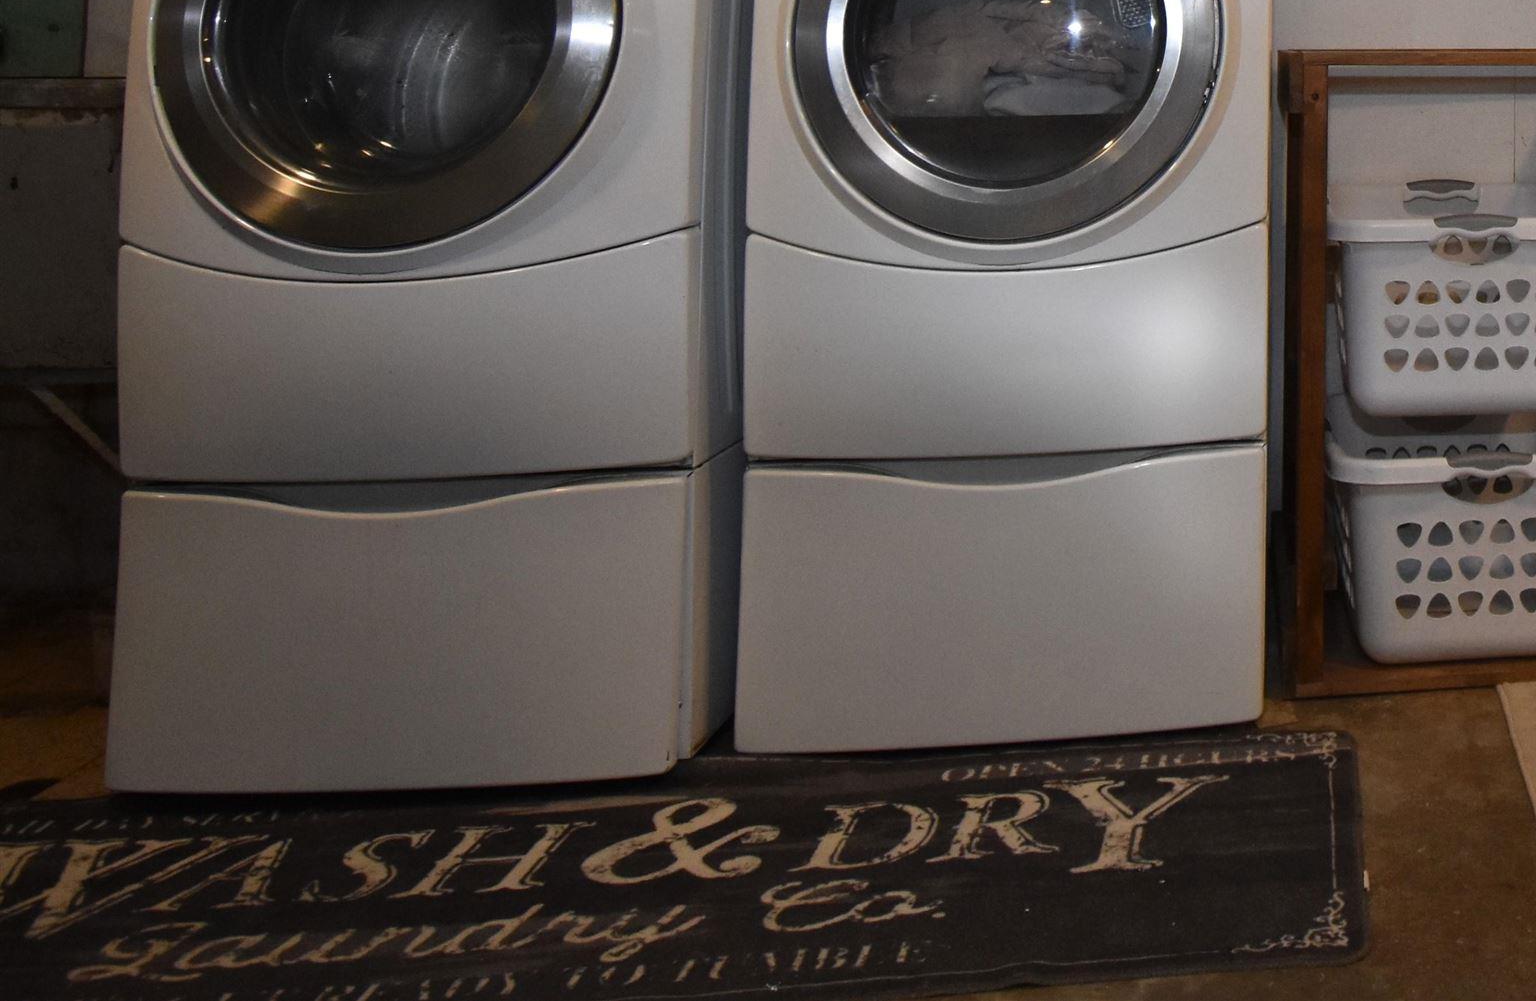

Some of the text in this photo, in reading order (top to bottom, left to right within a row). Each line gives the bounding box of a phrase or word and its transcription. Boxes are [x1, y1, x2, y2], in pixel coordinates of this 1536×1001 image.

[580, 797, 780, 885] &
[787, 774, 1230, 874] DRY
[67, 902, 706, 982] Laundry
